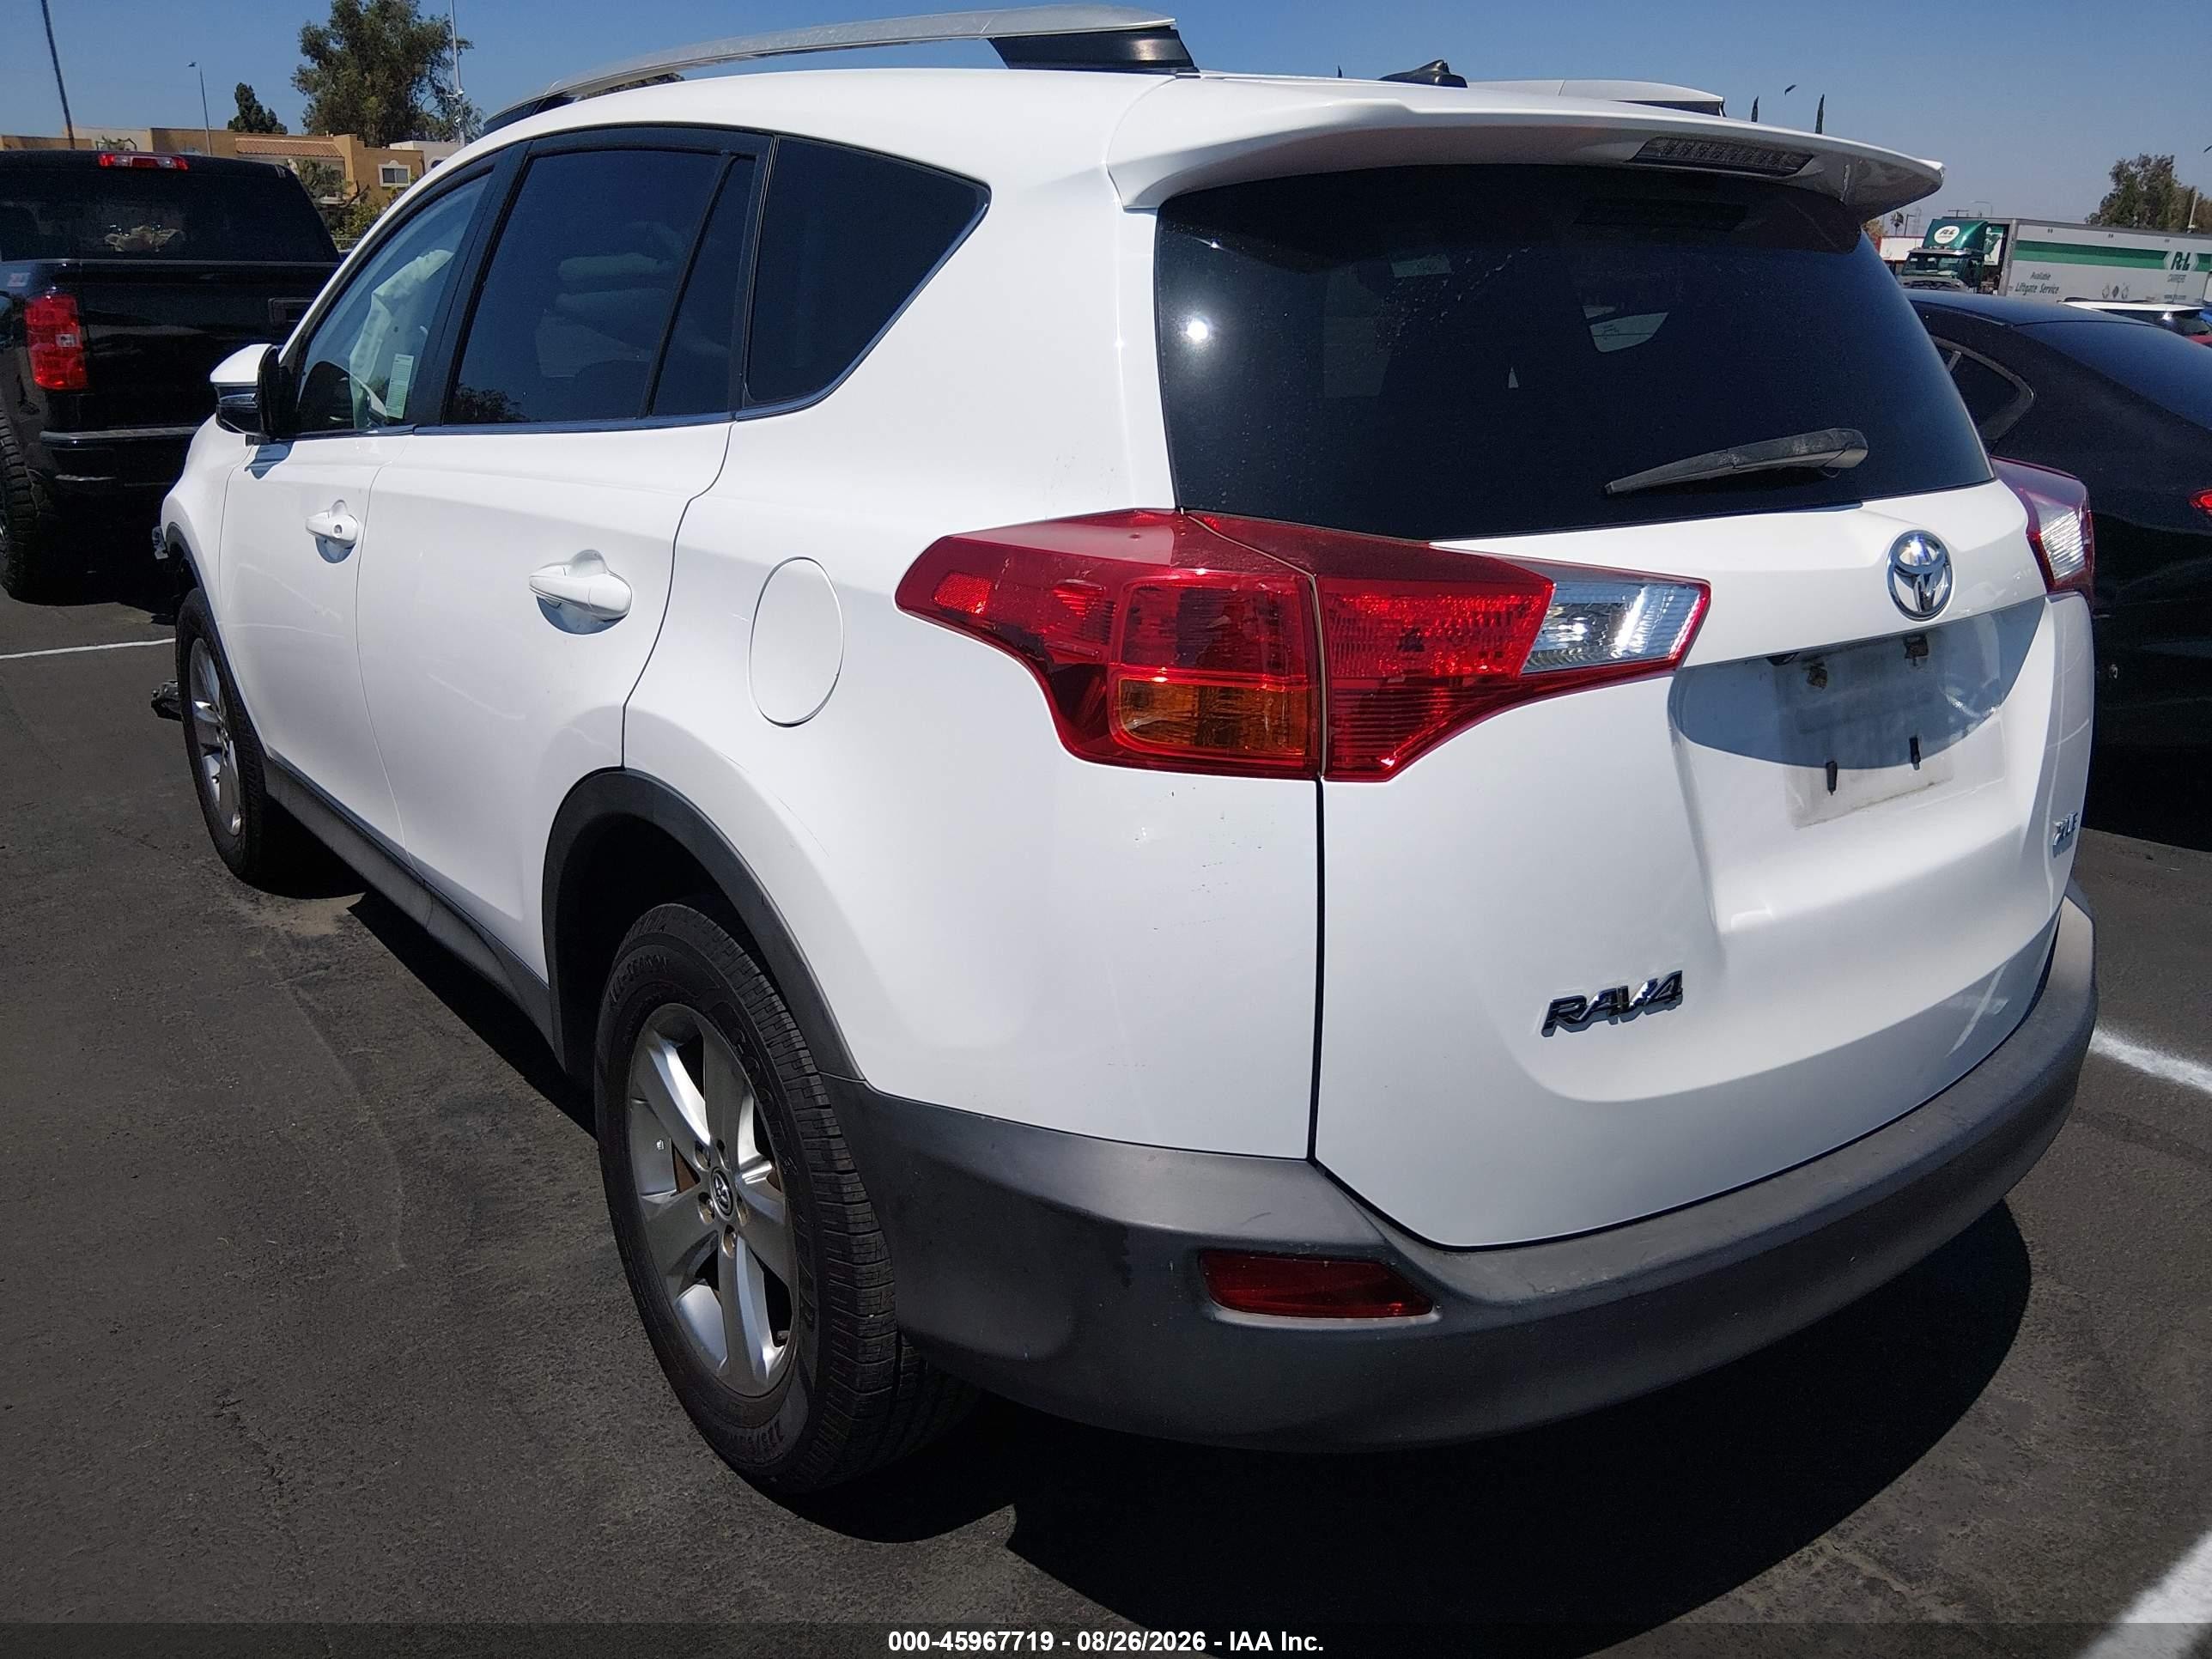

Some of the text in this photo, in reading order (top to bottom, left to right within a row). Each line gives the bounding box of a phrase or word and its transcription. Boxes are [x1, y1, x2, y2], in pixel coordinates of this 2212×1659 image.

[2014, 282, 2038, 295] Liftgate
[2039, 283, 2060, 295] Service
[1541, 969, 1683, 1037] RAV4
